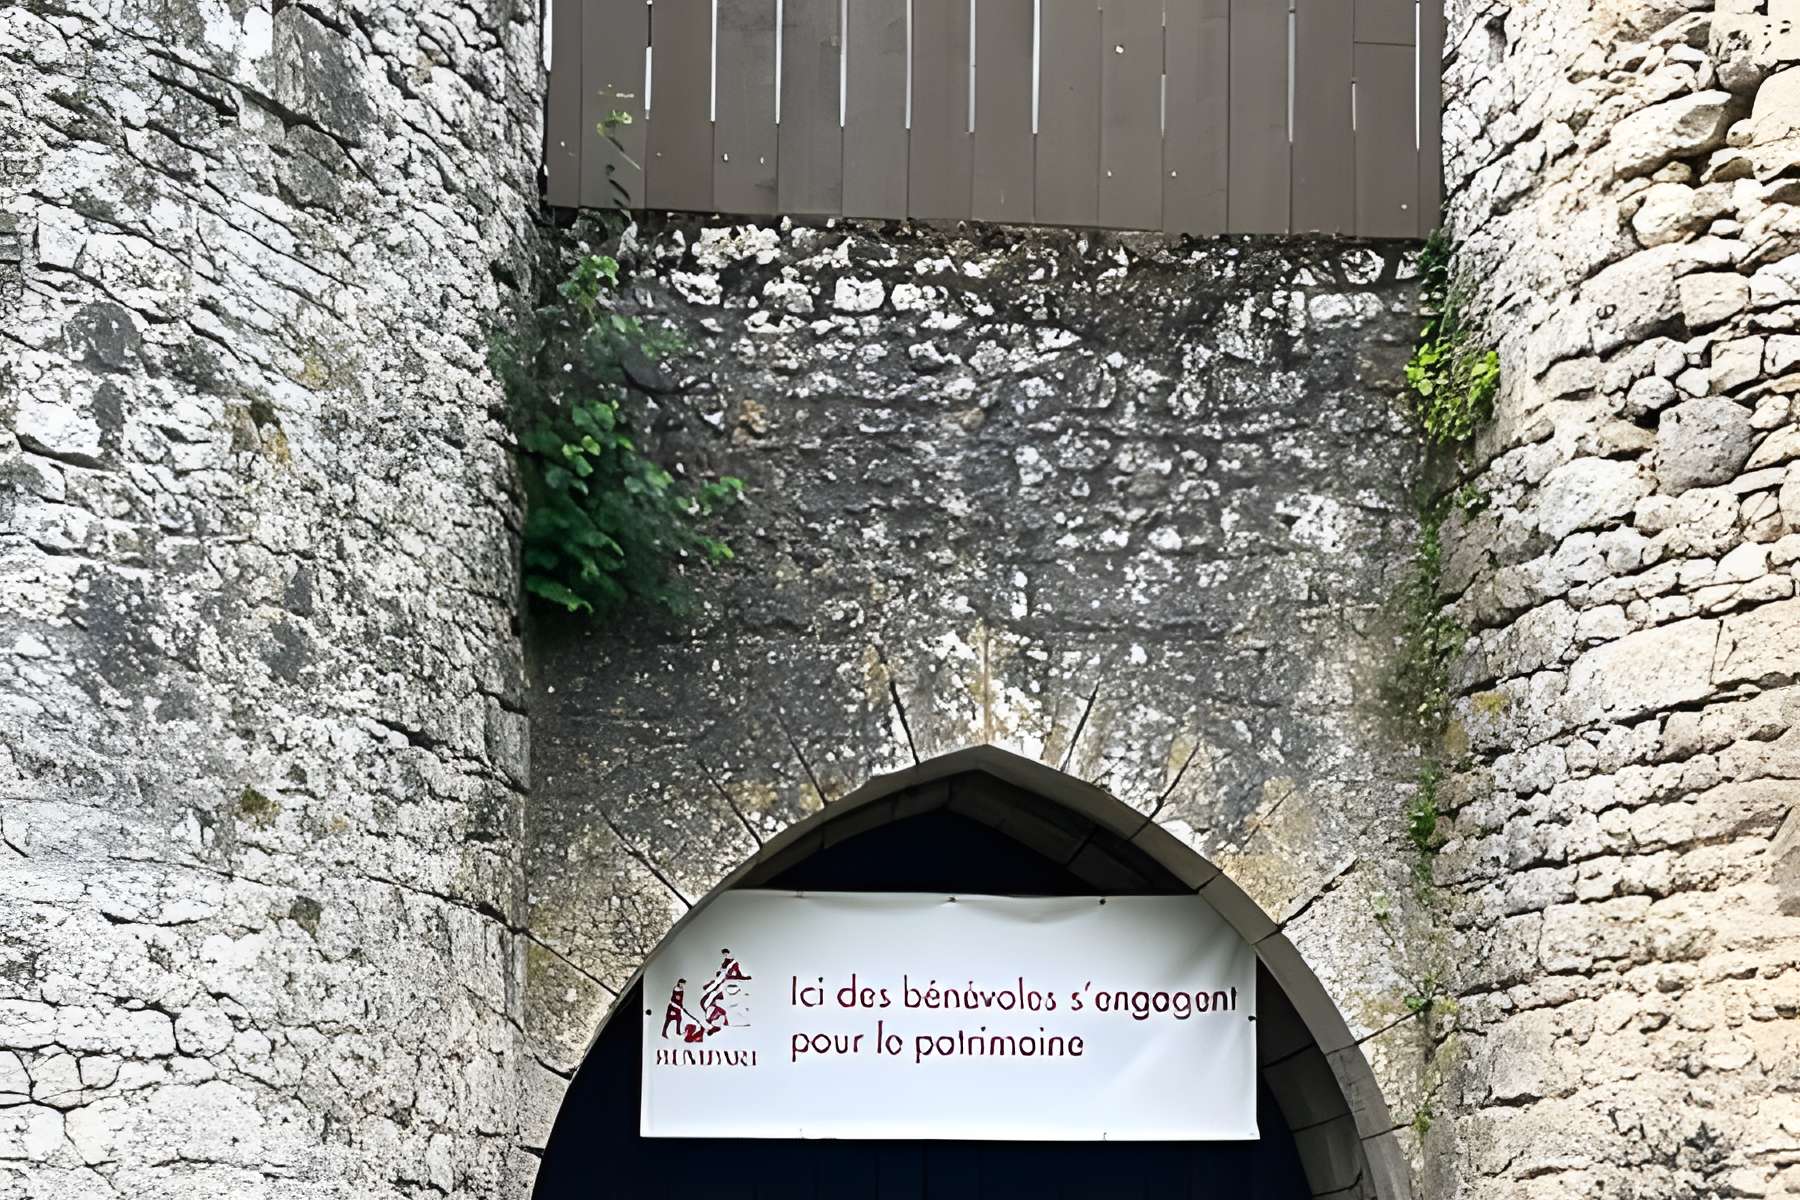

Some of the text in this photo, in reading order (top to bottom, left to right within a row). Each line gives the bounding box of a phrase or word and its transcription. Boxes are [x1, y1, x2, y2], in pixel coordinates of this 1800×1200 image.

[792, 975, 824, 1007] Ici
[837, 973, 891, 1008] des
[904, 974, 1057, 1011] bénévoles
[792, 1032, 864, 1062] pour
[916, 1026, 1084, 1064] patrimoine
